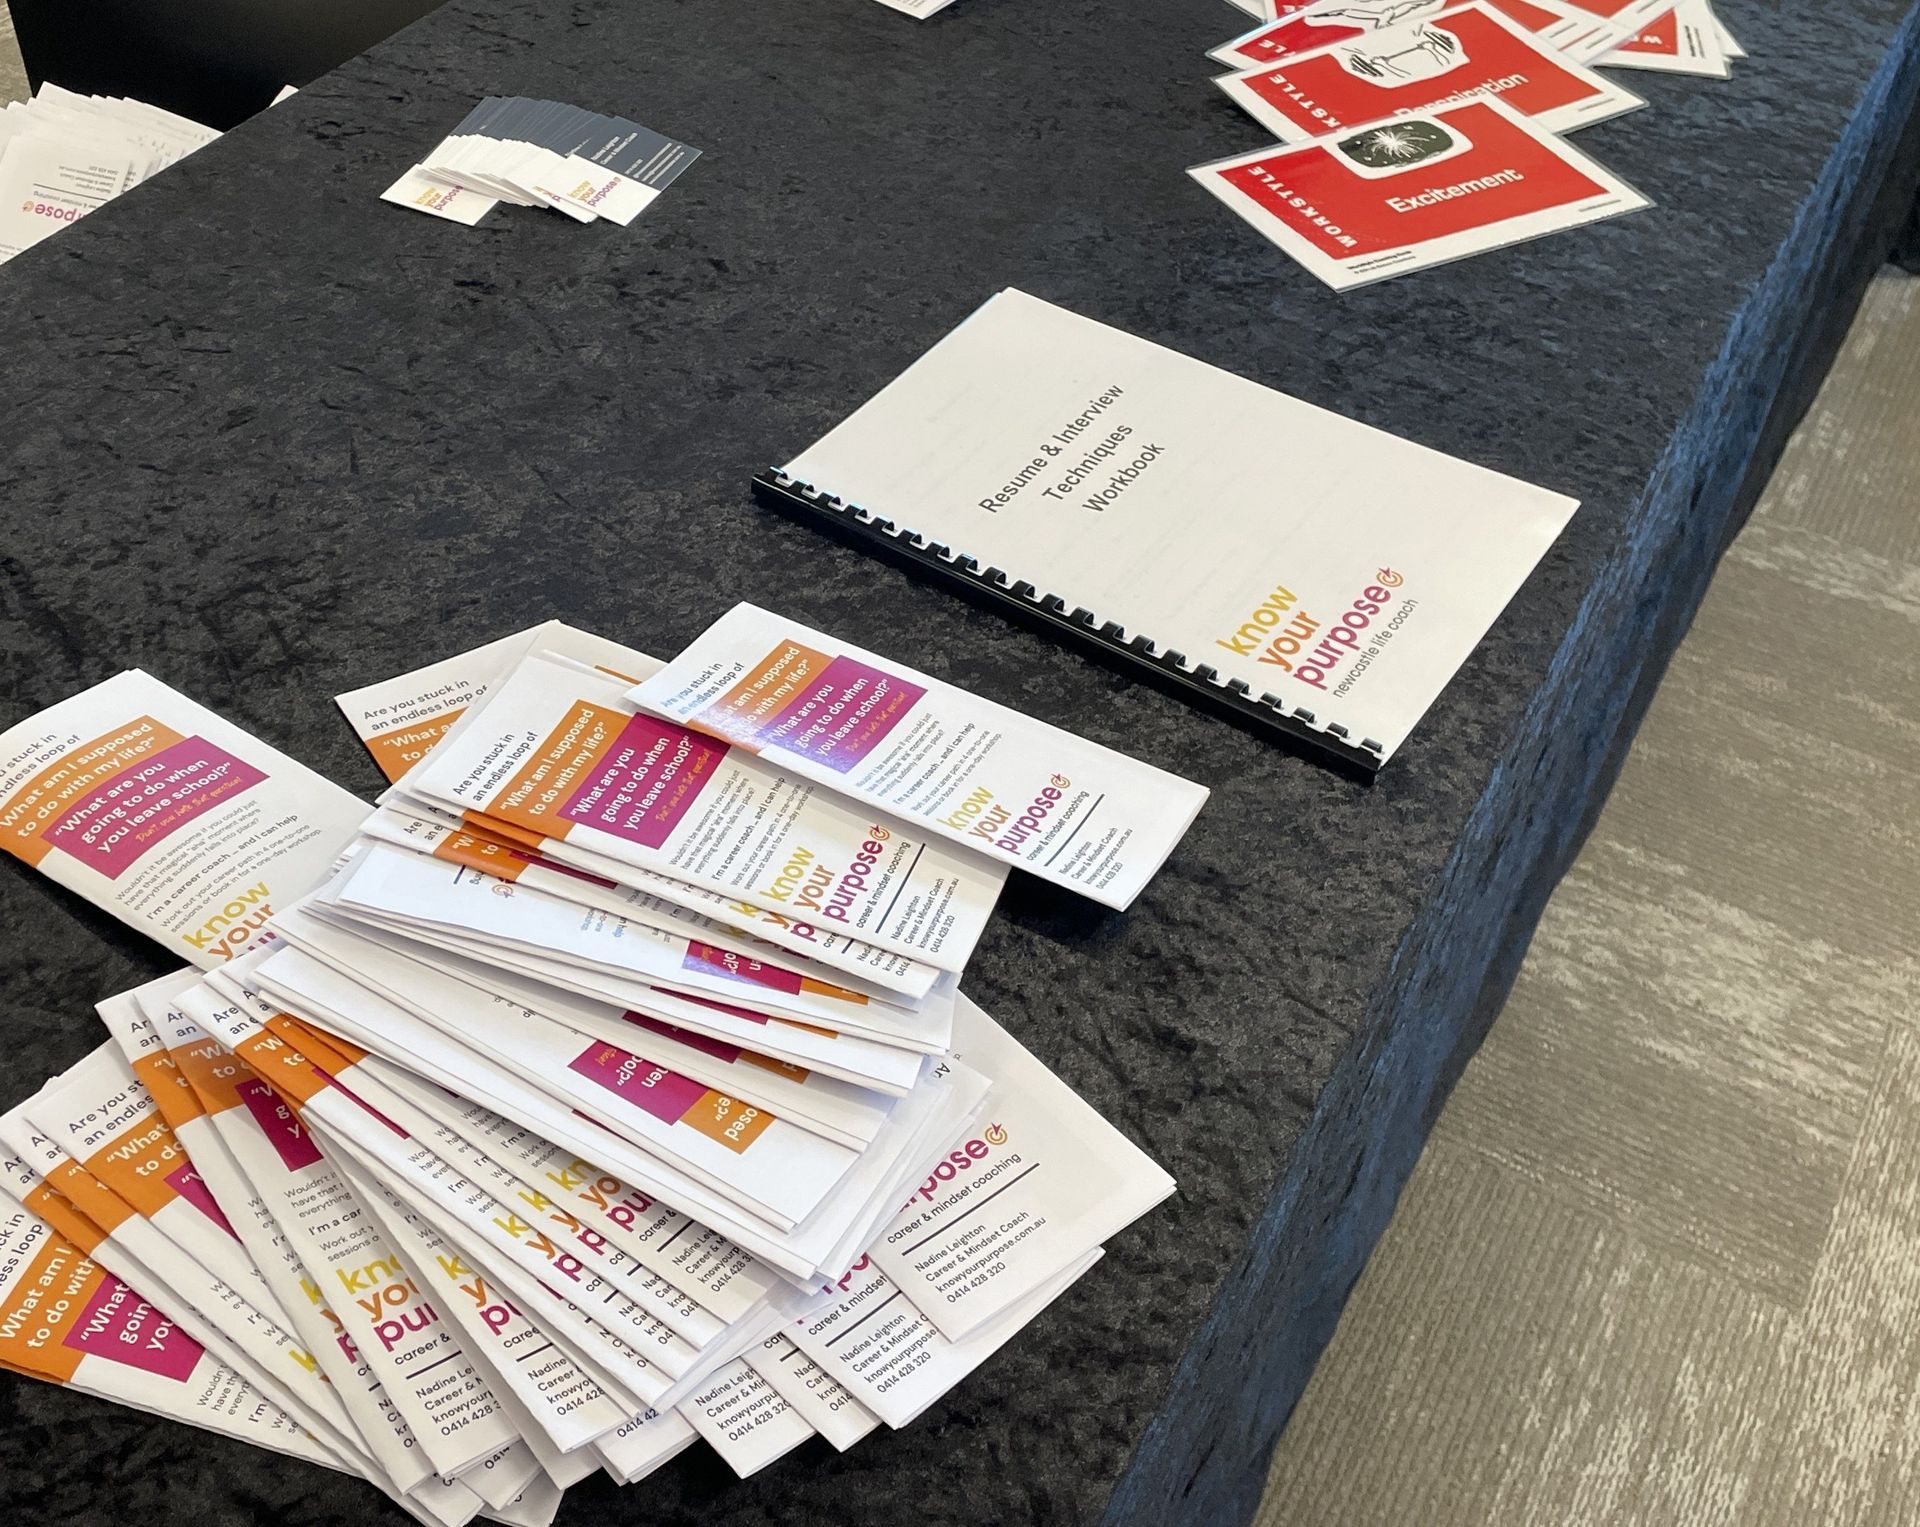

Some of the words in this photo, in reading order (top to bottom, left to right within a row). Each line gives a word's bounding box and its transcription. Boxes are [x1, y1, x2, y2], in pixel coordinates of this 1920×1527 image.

[1268, 73, 1342, 128] KSTYLE
[35, 204, 77, 221] pose
[1247, 166, 1358, 248] WORKSTYLE
[1384, 168, 1525, 213] Excitement
[978, 457, 1048, 513] Resume
[1052, 384, 1124, 444] Interview
[1042, 424, 1133, 500] Techniques
[1082, 442, 1165, 512] Workbook
[1216, 585, 1297, 656] know
[1257, 610, 1320, 672] your
[1293, 586, 1391, 691] purpose
[1333, 647, 1379, 698] newcastle
[1371, 629, 1393, 650] life
[1389, 598, 1418, 630] coach
[364, 707, 387, 719] Are
[390, 699, 414, 714] you
[418, 684, 454, 703] stuck
[455, 680, 469, 689] in
[372, 720, 389, 731] an
[391, 704, 442, 724] endless
[444, 692, 473, 707] loop
[795, 724, 826, 746] going
[817, 715, 832, 724] to
[828, 703, 844, 714] do
[840, 679, 868, 702] when
[798, 702, 818, 717] are
[812, 685, 834, 703] you
[44, 770, 73, 790] am
[78, 724, 152, 764] supposed
[532, 765, 551, 780] am
[550, 709, 600, 760] supposed
[816, 740, 836, 756] you
[828, 716, 861, 741] leave
[108, 781, 137, 798] are
[134, 764, 165, 782] you
[453, 780, 472, 795] Are
[469, 765, 486, 781] you
[483, 743, 506, 765] stuck
[473, 790, 487, 801] an
[484, 761, 514, 789] endless
[507, 743, 530, 760] loop
[527, 732, 538, 741] of
[529, 804, 546, 814] to
[541, 790, 558, 802] do
[554, 768, 577, 788] with
[572, 750, 593, 766] my
[601, 769, 618, 786] are
[614, 748, 634, 768] you
[601, 794, 632, 823] going
[621, 782, 637, 792] to
[631, 767, 648, 780] do
[643, 738, 670, 765] when
[18, 822, 36, 836] to
[38, 801, 58, 818] do
[58, 775, 96, 800] with
[92, 756, 120, 774] my
[82, 807, 126, 843] going
[123, 796, 142, 808] to
[144, 782, 168, 796] do
[165, 761, 208, 782] when
[624, 810, 645, 830] you
[636, 782, 665, 809] leave
[936, 786, 994, 830] know
[968, 804, 1011, 842] your
[995, 788, 1062, 855] purpose
[98, 827, 130, 852] you
[126, 799, 174, 827] leave
[171, 874, 200, 898] career
[202, 854, 232, 874] coach
[238, 837, 258, 850] and
[261, 826, 280, 838] can
[276, 815, 300, 829] help
[759, 847, 816, 904] know
[822, 841, 882, 923] purpose
[856, 906, 872, 928] career
[872, 874, 890, 900] mindset
[887, 841, 912, 875] coaching
[182, 882, 269, 949] know
[794, 865, 834, 912] your
[904, 925, 919, 944] Career
[917, 896, 937, 920] Mindset
[930, 878, 946, 897] Coach
[916, 878, 961, 950] knowyourpurpose.com.au
[208, 904, 274, 961] your
[891, 920, 907, 940] Nadine
[903, 895, 924, 921] Leighton
[928, 936, 942, 952] 0414
[938, 925, 951, 938] 428
[943, 916, 957, 928] 320
[68, 1111, 97, 1134] Are
[96, 1092, 126, 1118] you
[84, 1128, 105, 1147] an
[105, 1096, 154, 1133] endles
[887, 1219, 923, 1244] career
[931, 1185, 973, 1219] mindset
[972, 1153, 1022, 1189] coaching
[918, 1139, 989, 1202] pose
[39, 1256, 66, 1287] am
[914, 1248, 948, 1273] Nadine
[949, 1224, 986, 1254] Leighton
[925, 1258, 959, 1282] Career
[966, 1229, 1001, 1257] Mindset
[999, 1210, 1030, 1233] Coach
[936, 1216, 1047, 1293] knowyourpurpose.com.au
[808, 1310, 843, 1336] career
[848, 1275, 888, 1308] mindset
[946, 1284, 970, 1304] 0414
[970, 1272, 989, 1290] 428
[988, 1261, 1007, 1279] 320
[394, 1336, 438, 1366] career
[839, 1336, 873, 1364] Nadine
[872, 1313, 906, 1341] Leighton
[852, 1346, 883, 1373] Career
[888, 1320, 922, 1347] Mindset
[876, 1376, 900, 1394] 0414
[899, 1364, 916, 1381] 428
[914, 1351, 932, 1368] 320
[441, 1417, 470, 1437] 0414
[472, 1403, 494, 1420] 428
